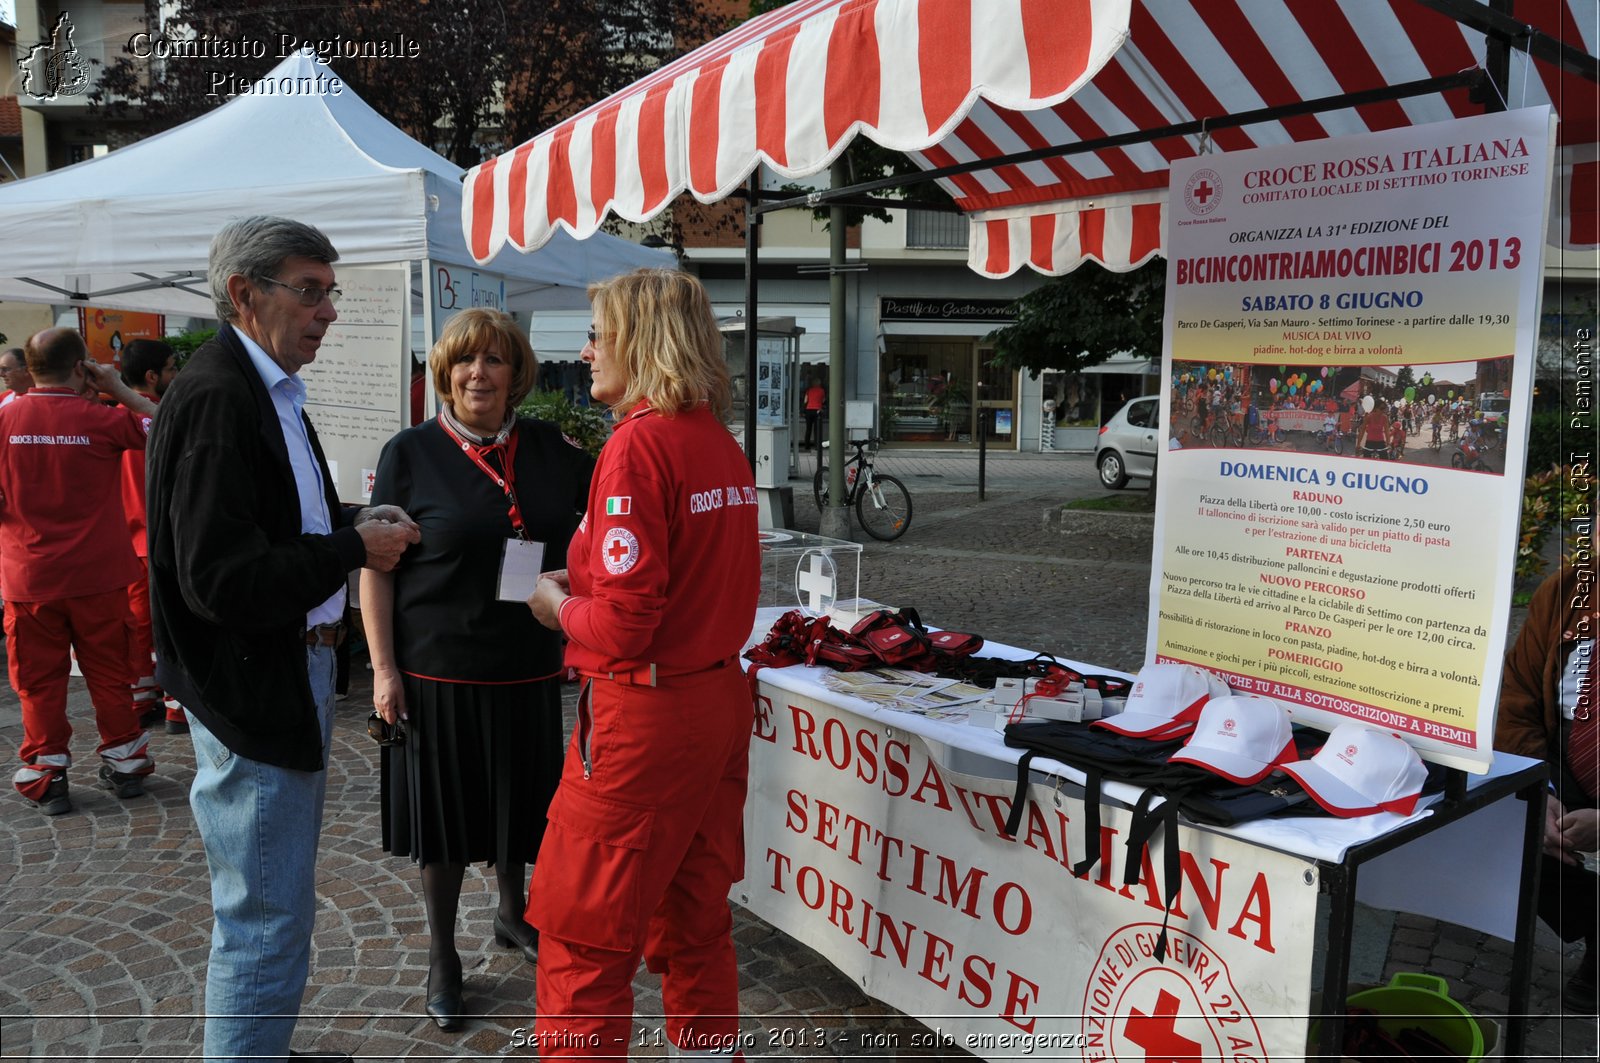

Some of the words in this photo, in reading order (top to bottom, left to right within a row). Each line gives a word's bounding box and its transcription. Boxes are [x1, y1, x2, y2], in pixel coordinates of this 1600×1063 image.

[1244, 164, 1315, 189] CROCE
[1322, 154, 1394, 180] ROSSA
[1402, 137, 1528, 171] ITALIANA
[1242, 188, 1307, 204] COMITATO
[1311, 182, 1361, 197] LOCALE
[1366, 180, 1379, 192] DI
[1383, 172, 1447, 189] SETTIMO
[1451, 163, 1528, 182] TORINESE
[1229, 228, 1302, 243] ORGANIZZA
[1307, 226, 1321, 238] LA
[1350, 218, 1418, 235] EDIZIONE
[1422, 215, 1448, 229] DEL
[1176, 242, 1440, 284] BICINCONTRIAMOCINBICI
[1448, 237, 1521, 272] 2013
[1242, 294, 1313, 312] SABATO
[1319, 294, 1329, 310] 8
[1336, 290, 1423, 309] GIUGNO
[1177, 320, 1198, 329] Parco
[1200, 320, 1210, 328] De
[1248, 318, 1260, 328] Via
[1263, 319, 1278, 328] San
[1280, 318, 1309, 327] Mauro
[1318, 317, 1353, 327] Settimo
[1355, 316, 1394, 326] Torinese
[1412, 315, 1445, 329] partire
[1448, 314, 1474, 325] dalle
[1479, 314, 1509, 326] 19,30
[1282, 331, 1320, 341] MUSICA
[1322, 331, 1342, 341] DAL
[1344, 331, 1371, 341] VIVO
[1289, 344, 1323, 357] hot-dog
[1334, 344, 1355, 355] birra
[1367, 345, 1402, 355] volontà
[9, 435, 33, 445] CROCE
[33, 435, 56, 445] ROSSA
[56, 435, 90, 445] ITALIANA
[1220, 461, 1319, 485] DOMENICA
[1326, 471, 1335, 486] 9
[1342, 472, 1428, 495] GIUGNO
[690, 488, 723, 515] CROCE
[1199, 494, 1224, 506] Piazza
[1227, 497, 1246, 508] della
[1249, 500, 1277, 512] Libertà
[1280, 505, 1294, 513] ore
[1298, 505, 1321, 516] 10,00
[1329, 511, 1353, 520] costo
[1355, 511, 1400, 526] iscrizione
[1403, 518, 1424, 529] 2,50
[1427, 523, 1450, 532] euro
[1293, 490, 1342, 505] RADUNO
[1205, 508, 1245, 521] talloncino
[1258, 513, 1298, 527] iscrizione
[1301, 520, 1319, 530] sarà
[1321, 522, 1347, 534] valido
[1349, 527, 1364, 537] per
[1382, 529, 1410, 541] piatto
[1424, 537, 1450, 547] pasta
[1252, 528, 1265, 537] per
[1330, 539, 1346, 547] una
[1349, 538, 1391, 553] bicicletta
[1175, 545, 1189, 555] Alle
[1207, 550, 1228, 560] 10,45
[1231, 553, 1285, 569] distribuzione
[1287, 562, 1329, 576] palloncini
[1338, 569, 1398, 587] degustazione
[1400, 581, 1441, 594] prodotti
[1443, 586, 1475, 600] offerti
[1286, 547, 1342, 564] PARTENZA
[1163, 571, 1187, 583] Nuovo
[1189, 577, 1222, 589] percorso
[1225, 582, 1235, 591] tra
[1248, 585, 1259, 595] vie
[1262, 588, 1298, 602] cittadine
[1318, 597, 1353, 612] ciclabile
[1367, 606, 1402, 621] Settimo
[1405, 616, 1422, 625] con
[1425, 619, 1470, 634] partenza
[1473, 625, 1486, 637] da
[1260, 573, 1301, 588] NUOVO
[1304, 580, 1365, 600] PERCORSO
[1167, 584, 1191, 596] Piazza
[1193, 588, 1211, 600] della
[1214, 592, 1241, 605] Libertà
[1255, 601, 1280, 612] arrivo
[1293, 606, 1316, 618] Parco
[1318, 610, 1330, 621] De
[1333, 613, 1365, 629] Gasperi
[1367, 623, 1383, 632] per
[1396, 629, 1413, 638] ore
[1417, 630, 1444, 644] 12,00
[1285, 621, 1331, 638] PRANZO
[1158, 609, 1193, 625] Possibilità
[1204, 620, 1250, 636] ristorazione
[1262, 630, 1280, 642] loco
[1282, 637, 1298, 645] con
[1362, 651, 1396, 671] hot-dog
[1406, 661, 1428, 675] birra
[1268, 648, 1343, 672] POMERIGGIO
[1165, 640, 1207, 656] Animazione
[1216, 651, 1240, 664] giochi
[1242, 659, 1256, 667] per
[1263, 661, 1277, 672] più
[1313, 674, 1356, 690] estrazione
[1358, 685, 1421, 707] sottoscrizione
[1256, 681, 1269, 693] TU
[1273, 684, 1301, 700] ALLA
[1305, 691, 1407, 727] SOTTOSCRIZIONE
[1411, 719, 1420, 730] A
[1424, 723, 1471, 744] PREMI!
[788, 704, 953, 812] ROSSA
[785, 788, 1033, 936] SETTIMO
[766, 849, 1040, 1034] TORINESE
[1115, 939, 1138, 968] DI
[1210, 994, 1242, 1028] 22
